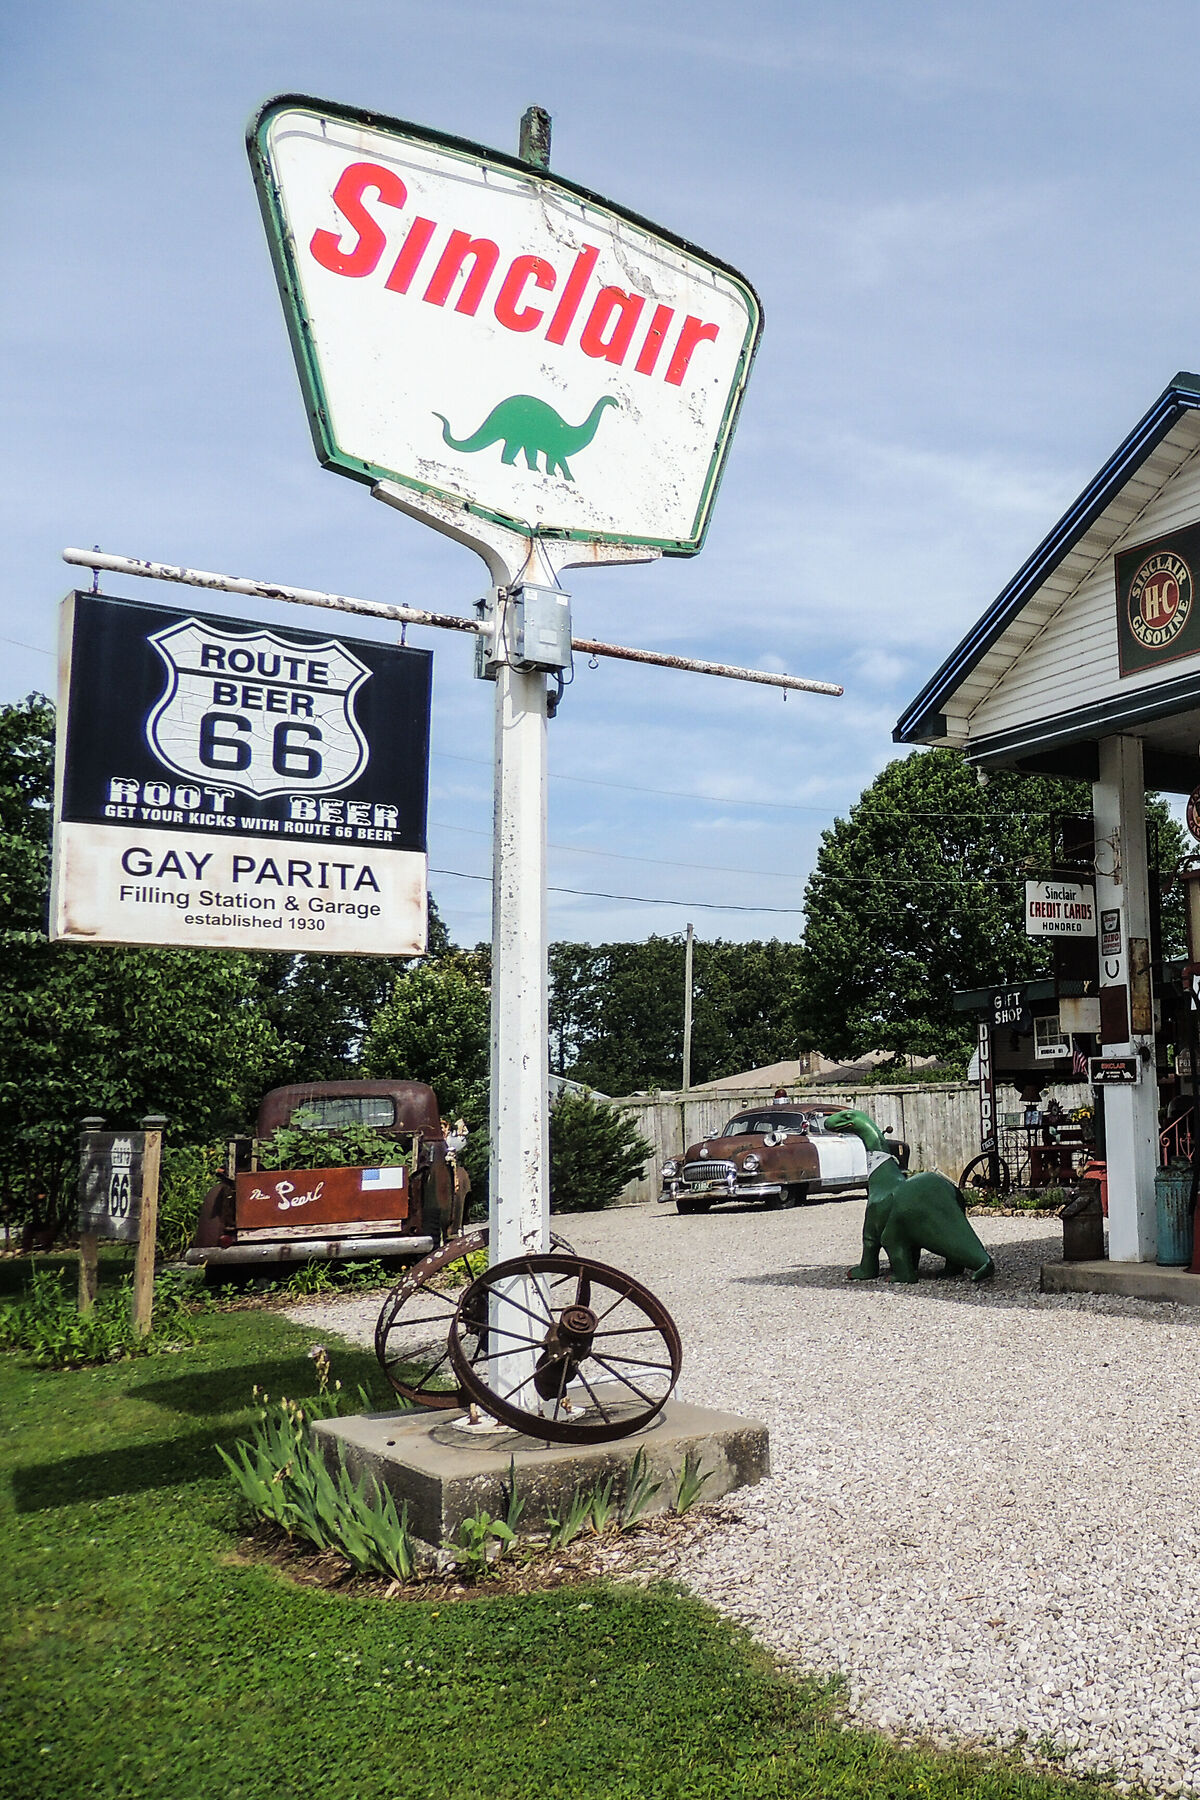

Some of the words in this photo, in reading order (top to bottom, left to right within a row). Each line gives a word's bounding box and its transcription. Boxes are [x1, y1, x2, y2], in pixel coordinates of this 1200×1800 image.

[309, 161, 720, 386] Sinclair
[1132, 556, 1187, 599] SINCLAIR
[1132, 600, 1188, 645] GASOLINE
[200, 643, 329, 685] ROUTE
[212, 682, 314, 717] BEER
[199, 711, 323, 779] 66
[104, 804, 136, 819] GET
[141, 808, 183, 823] YOUR
[188, 812, 236, 828] KICKS
[241, 816, 279, 831] WITH
[284, 821, 331, 836] ROUTE
[334, 826, 353, 837] 66
[109, 777, 235, 812] ROOT
[289, 795, 399, 829] BEER
[121, 847, 214, 881] GAY
[232, 855, 381, 892] PARITA
[120, 885, 190, 909] Filling
[199, 890, 276, 909] Station
[284, 895, 300, 911] &
[308, 897, 381, 919] Garage
[1029, 901, 1061, 918] CREDIT
[1064, 903, 1093, 920] CARDS
[1045, 885, 1077, 901] Sinclair
[184, 913, 282, 929] established
[288, 917, 326, 931] 1930
[1042, 922, 1082, 932] HONORED
[994, 992, 1020, 1009] GIFT
[994, 1007, 1023, 1025] SHOP
[979, 1023, 992, 1140] DUNLOP
[111, 1174, 129, 1217] 66
